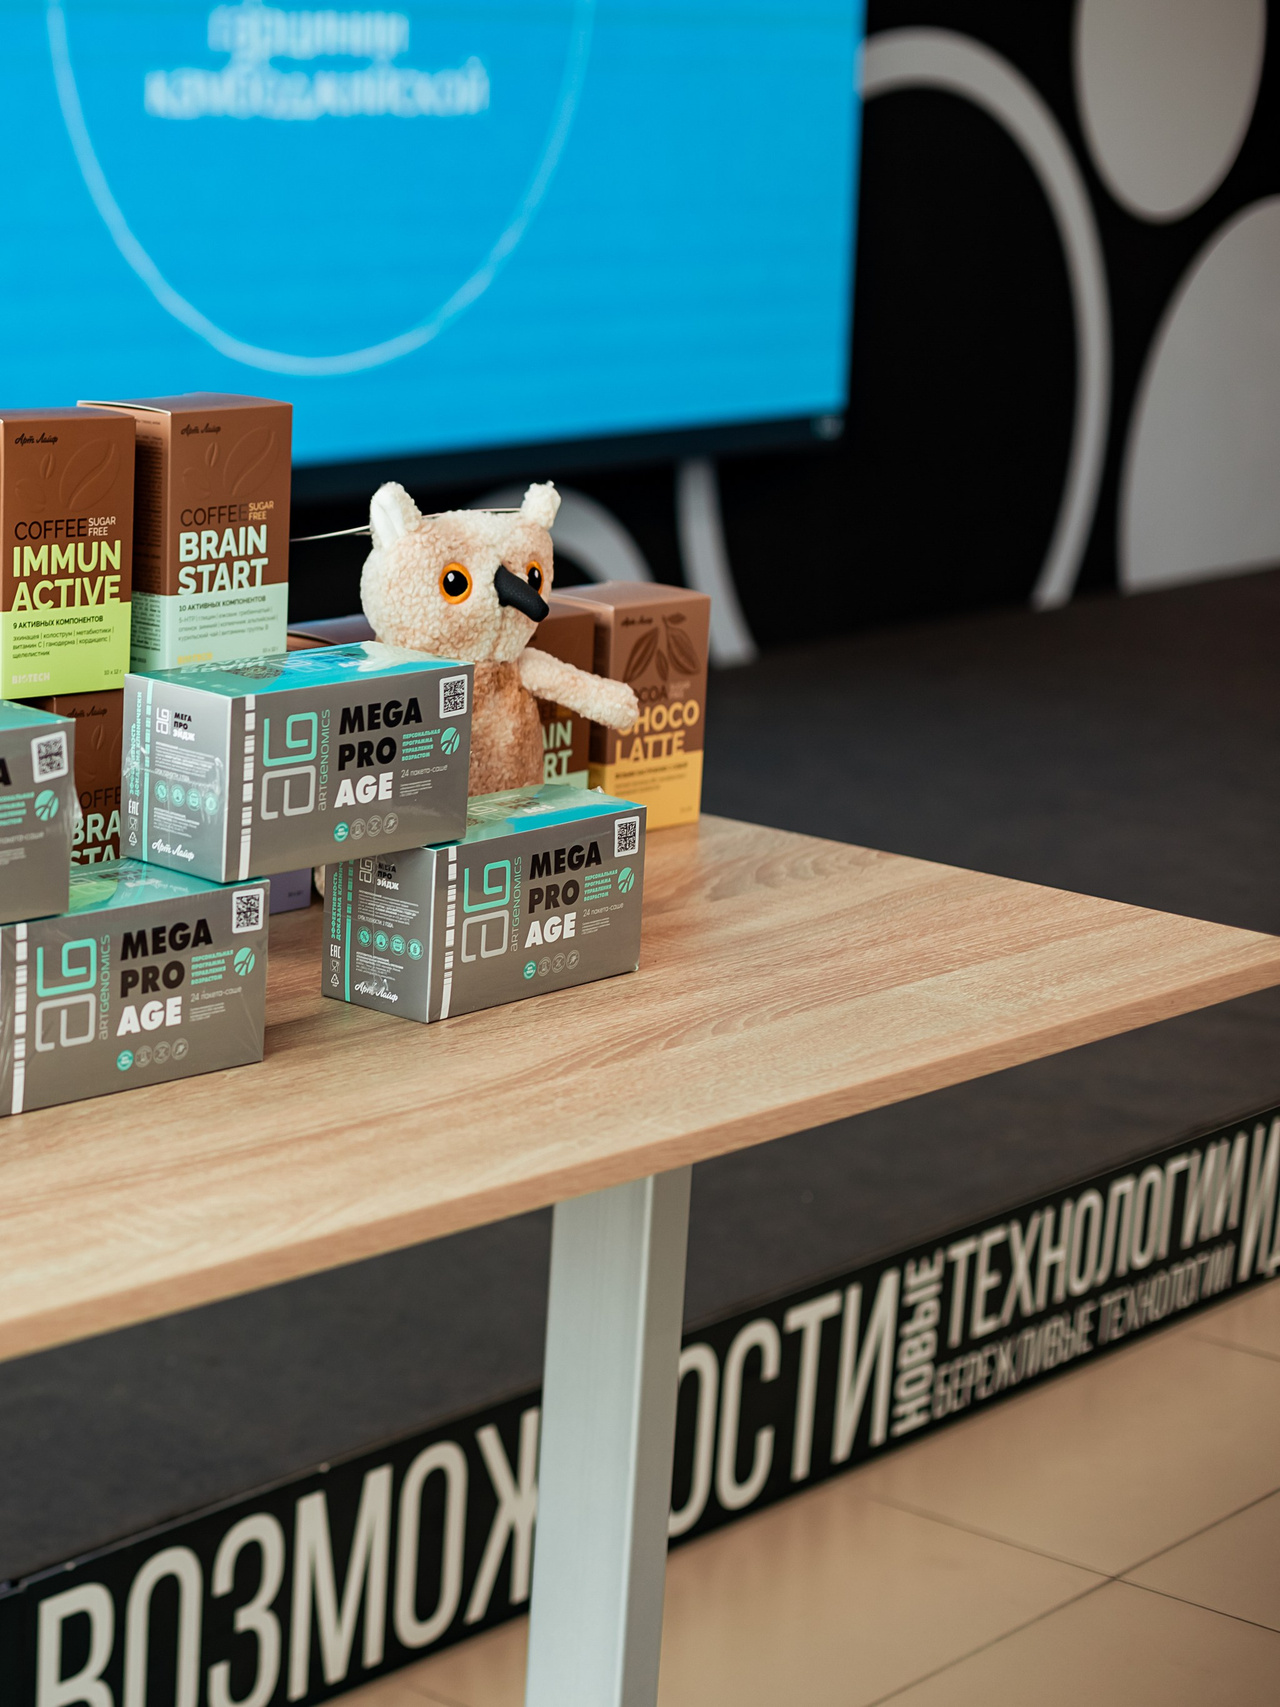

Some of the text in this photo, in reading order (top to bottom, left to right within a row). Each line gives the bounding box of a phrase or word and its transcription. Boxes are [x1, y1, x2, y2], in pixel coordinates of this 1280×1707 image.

[15, 431, 59, 445] Арт Лайф
[88, 516, 117, 528] SUGAR
[180, 503, 249, 528] COFFEE
[248, 500, 275, 512] SUGAR
[248, 510, 267, 521] FREE
[14, 517, 88, 541] COFFEE
[88, 526, 109, 537] FREE
[178, 524, 267, 563] BRAIN
[13, 539, 121, 578] IMMUN
[177, 557, 269, 597] START
[11, 574, 121, 614] ACTIVE
[18, 615, 104, 629] АКТИВНЫХ КОМПОНЕНТОВ
[339, 697, 423, 735] MEGA
[338, 736, 397, 771] PRO
[616, 730, 686, 763] LATTE
[334, 772, 394, 808] AGE
[529, 840, 602, 880] MEGA
[376, 878, 399, 891] ЭЙДЖ
[528, 878, 580, 914] PRO
[120, 918, 213, 962] MEGA
[524, 911, 577, 949] AGE
[120, 960, 185, 999] PRO
[116, 995, 183, 1037] AGE
[946, 1130, 1248, 1349] ТЕХНОЛОГИИ
[891, 1247, 946, 1438] НОВЫЕ
[931, 1240, 1236, 1420] БЕРЕЖЛИВЫЕ ТЕХНОЛОГИИ
